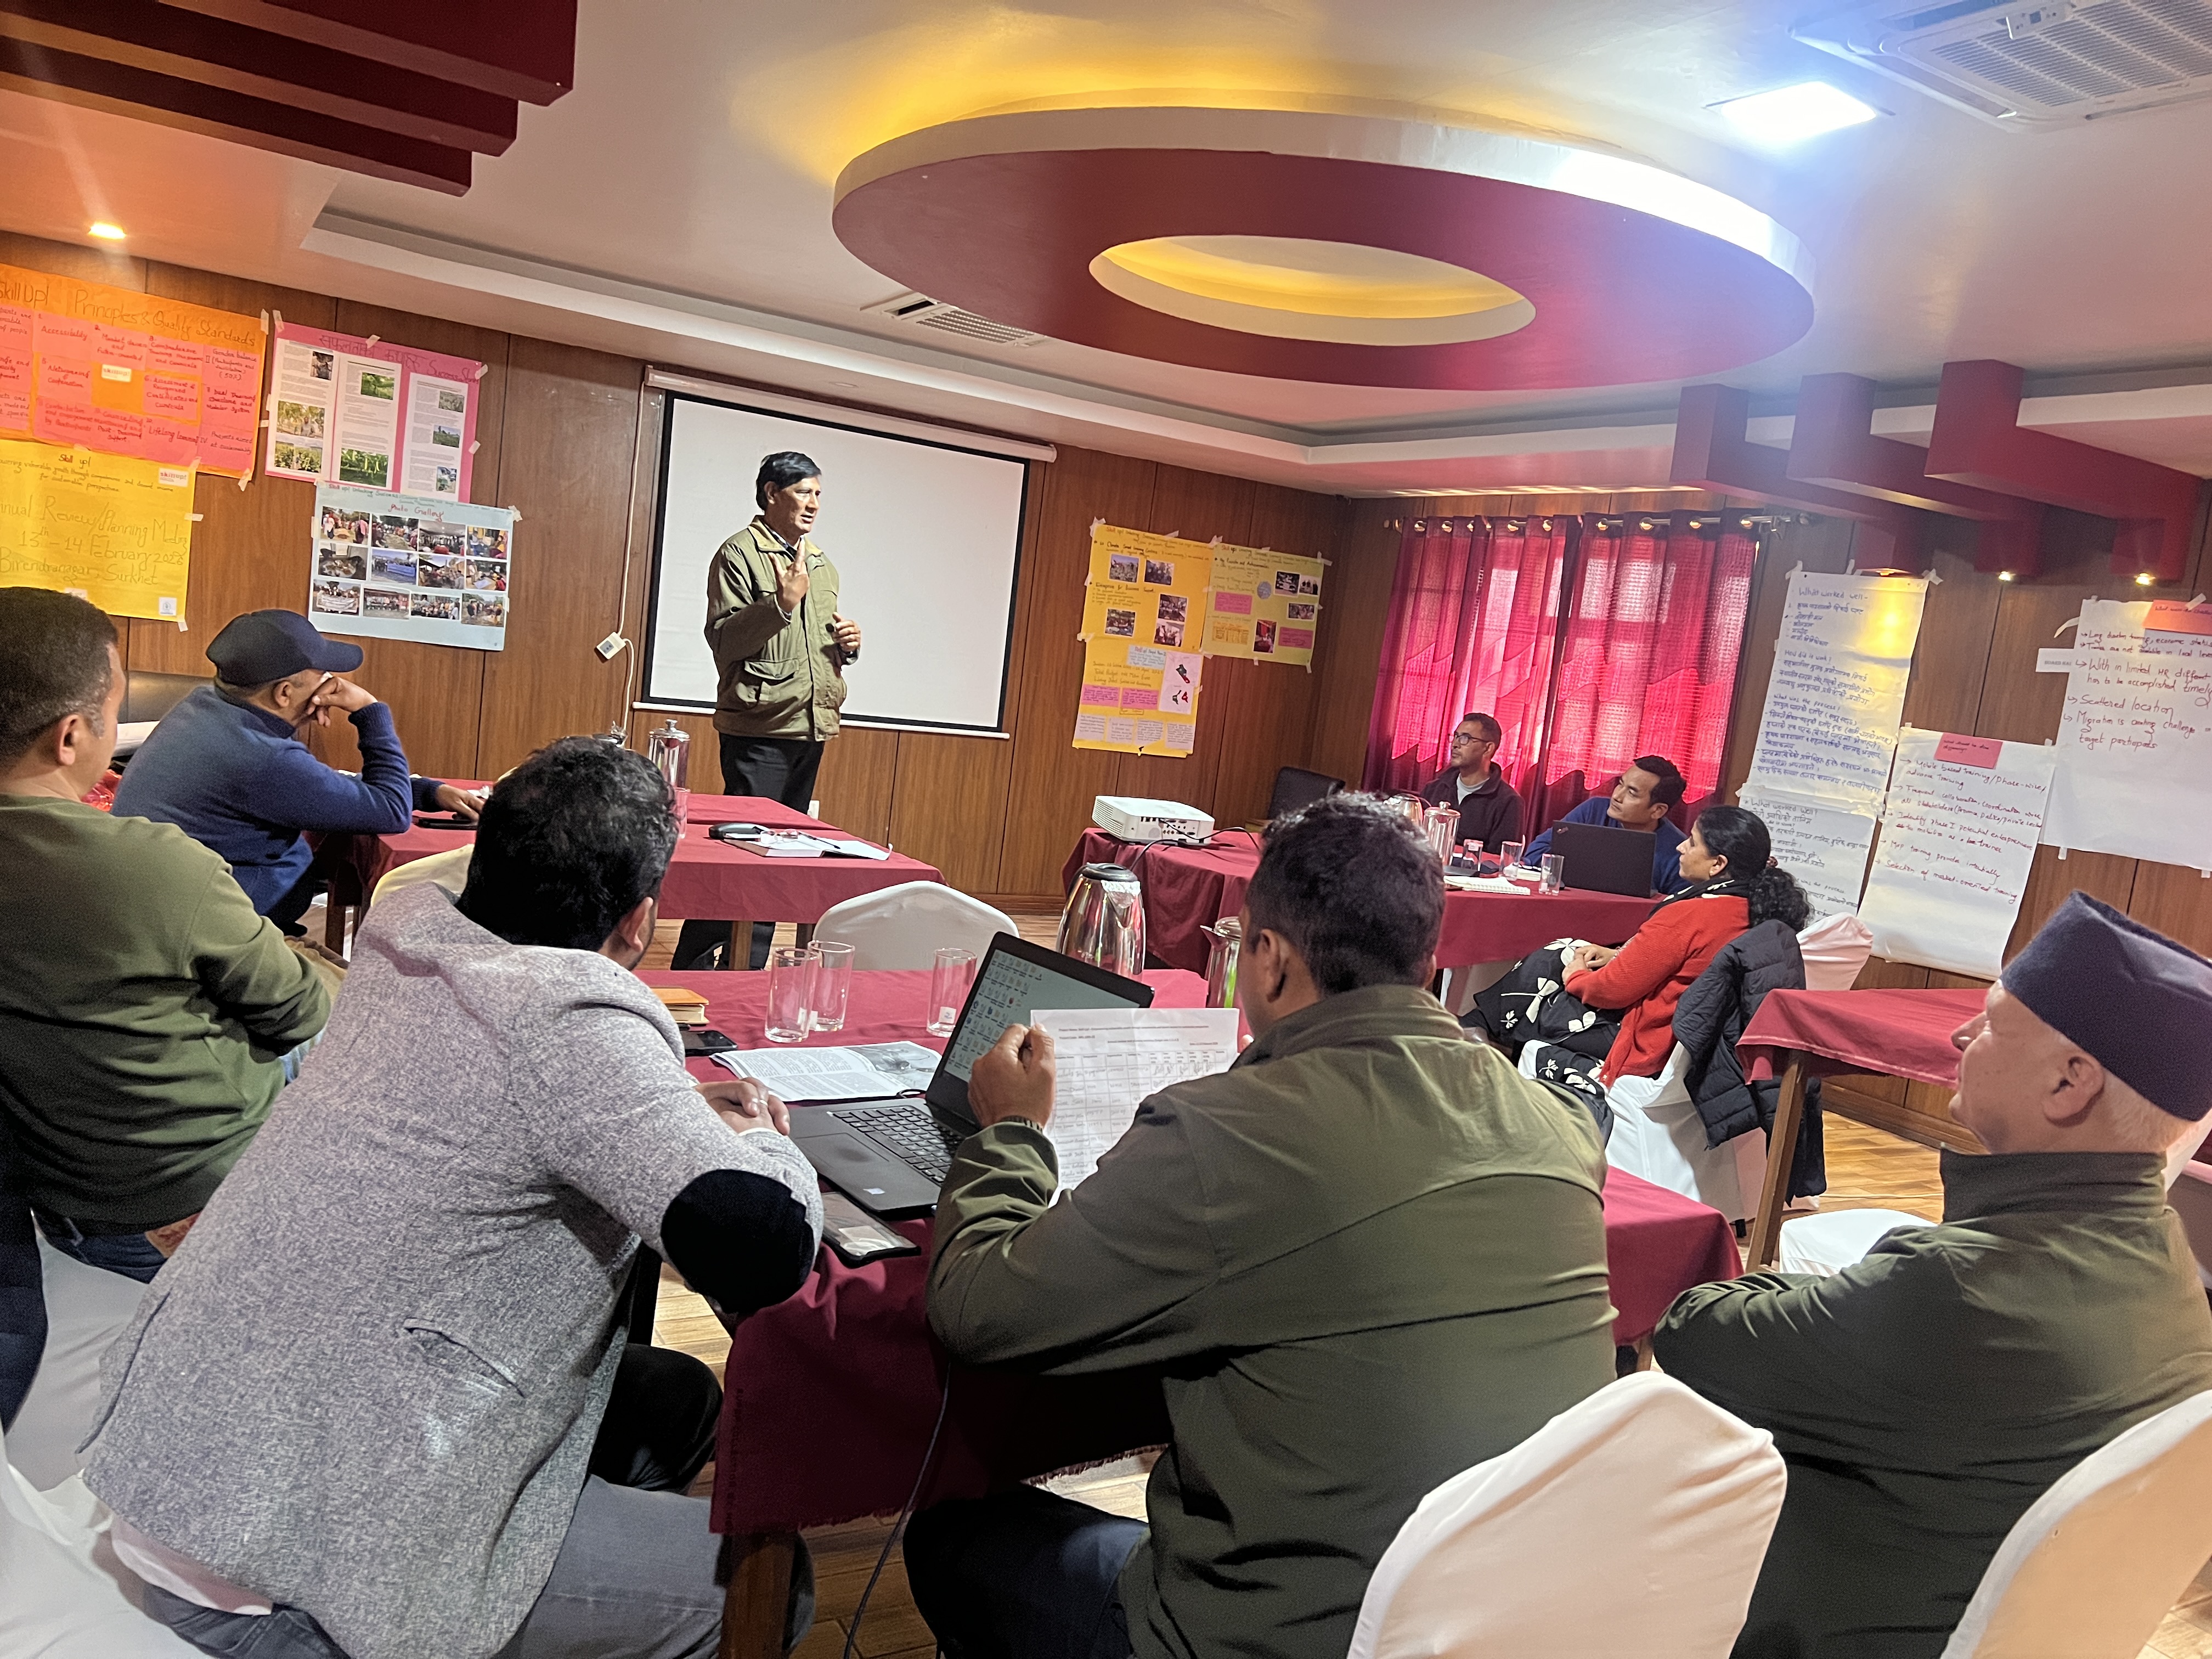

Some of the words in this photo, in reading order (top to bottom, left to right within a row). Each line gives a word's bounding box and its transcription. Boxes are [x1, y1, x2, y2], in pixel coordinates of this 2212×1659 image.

[75, 289, 138, 326] Principles
[153, 311, 191, 341] Quality
[196, 320, 256, 347] Standards
[90, 534, 153, 571] February
[103, 564, 159, 585] Surkhet
[1799, 586, 1819, 596] What
[1821, 590, 1844, 599] worked
[2122, 645, 2133, 653] not
[2089, 658, 2109, 672] With
[2158, 668, 2169, 679] HR
[2128, 678, 2176, 692] accomplished
[2080, 694, 2126, 709] Scattered
[2131, 696, 2174, 716] location
[2076, 710, 2113, 733] Migration
[2080, 732, 2104, 751] target
[1942, 764, 1962, 773] based
[1751, 798, 1770, 808] What
[1773, 804, 1797, 812] worked
[1959, 823, 1989, 836] potential
[1890, 840, 1904, 851] Map
[1885, 860, 1915, 873] Selection
[1921, 870, 1930, 880] of
[944, 1011, 953, 1020] 2
